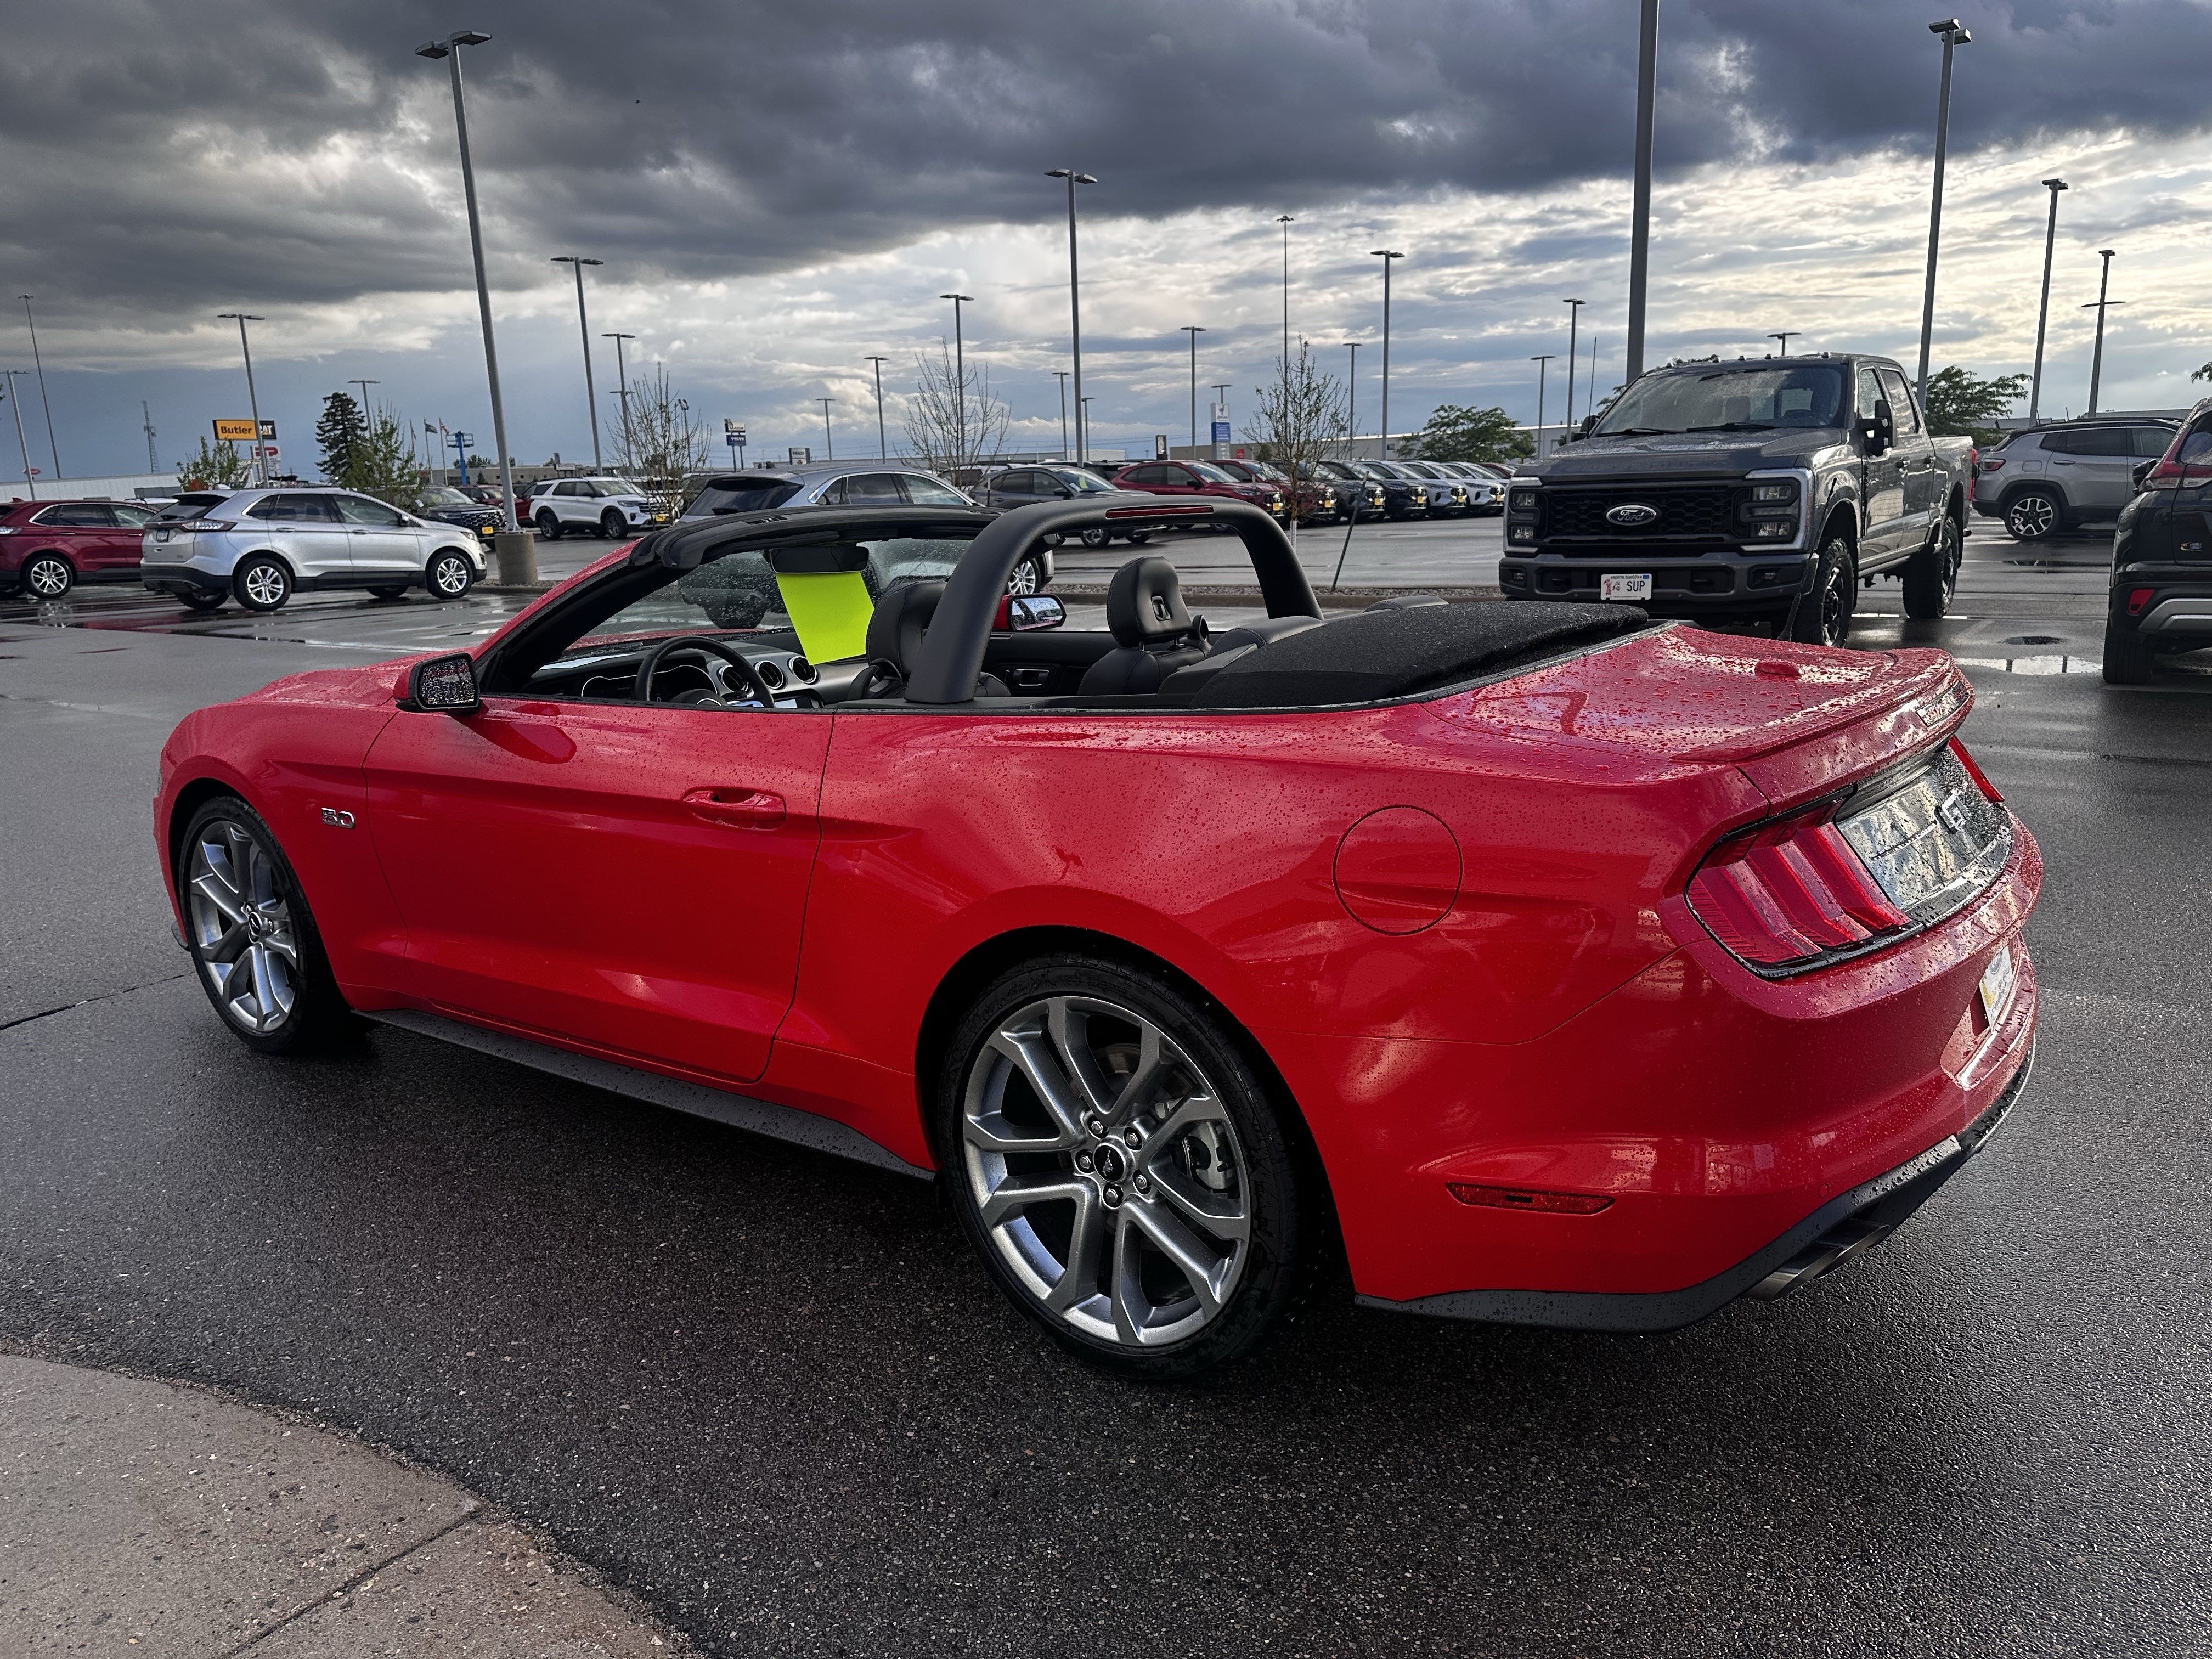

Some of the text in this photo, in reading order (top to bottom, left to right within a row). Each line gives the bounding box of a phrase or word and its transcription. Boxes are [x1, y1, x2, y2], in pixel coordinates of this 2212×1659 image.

[221, 426, 252, 435] Butler
[1617, 509, 1645, 521] Ford
[1627, 580, 1645, 592] SUP
